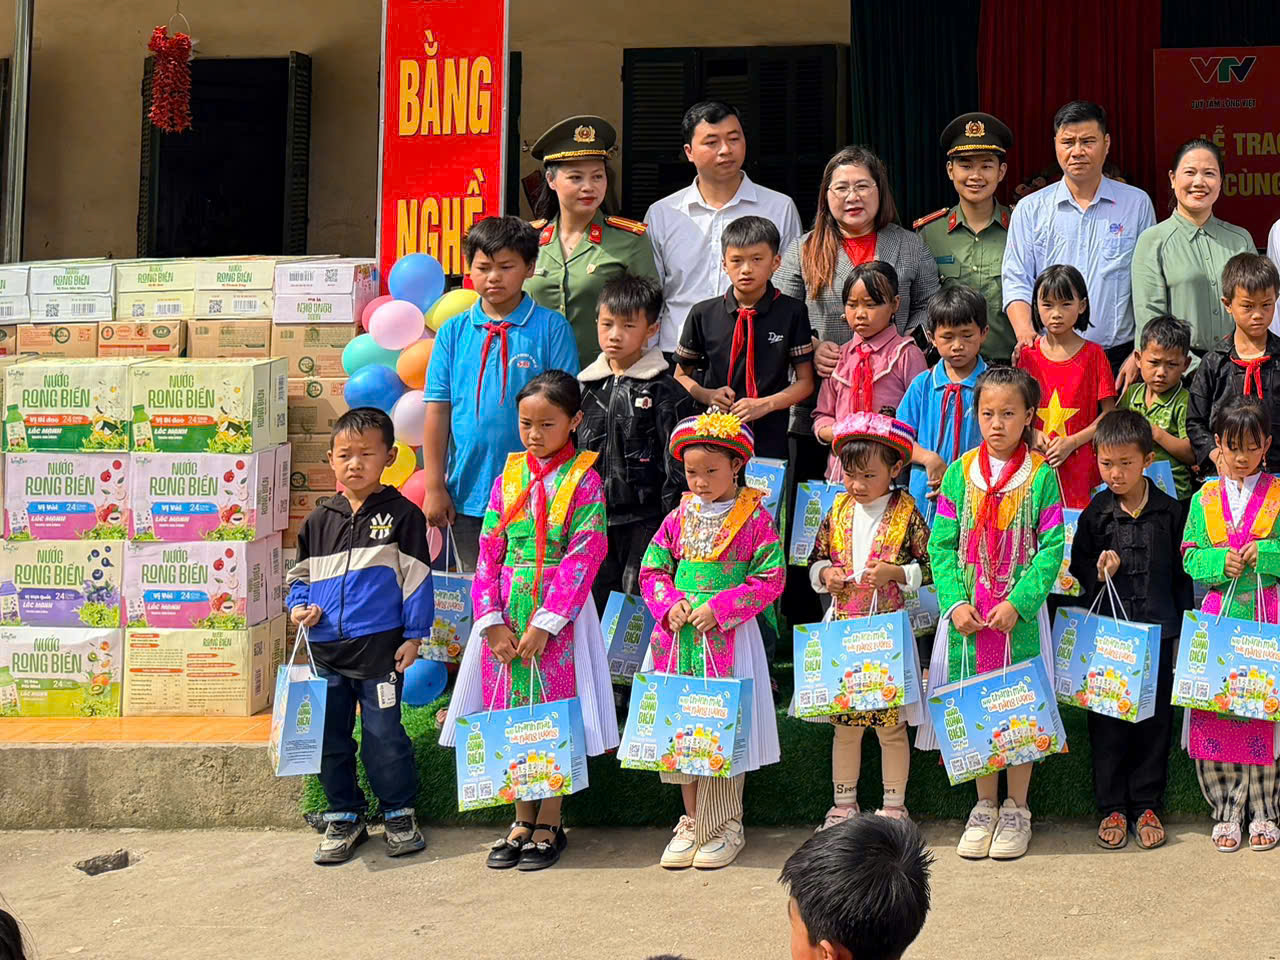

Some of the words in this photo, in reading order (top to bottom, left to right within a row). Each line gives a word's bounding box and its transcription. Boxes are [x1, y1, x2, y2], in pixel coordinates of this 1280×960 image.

[1190, 56, 1256, 83] VTV
[400, 30, 491, 137] BẰNG
[22, 389, 58, 408] RONG
[148, 389, 183, 408] RONG
[26, 476, 61, 496] RONG
[150, 477, 185, 496] RONG
[66, 503, 76, 511] 24
[189, 504, 200, 512] 24
[15, 564, 51, 585] RONG
[142, 564, 176, 584] RONG
[55, 592, 64, 600] 24
[181, 591, 190, 599] 24
[12, 652, 48, 673] RONG
[53, 680, 62, 688] 24
